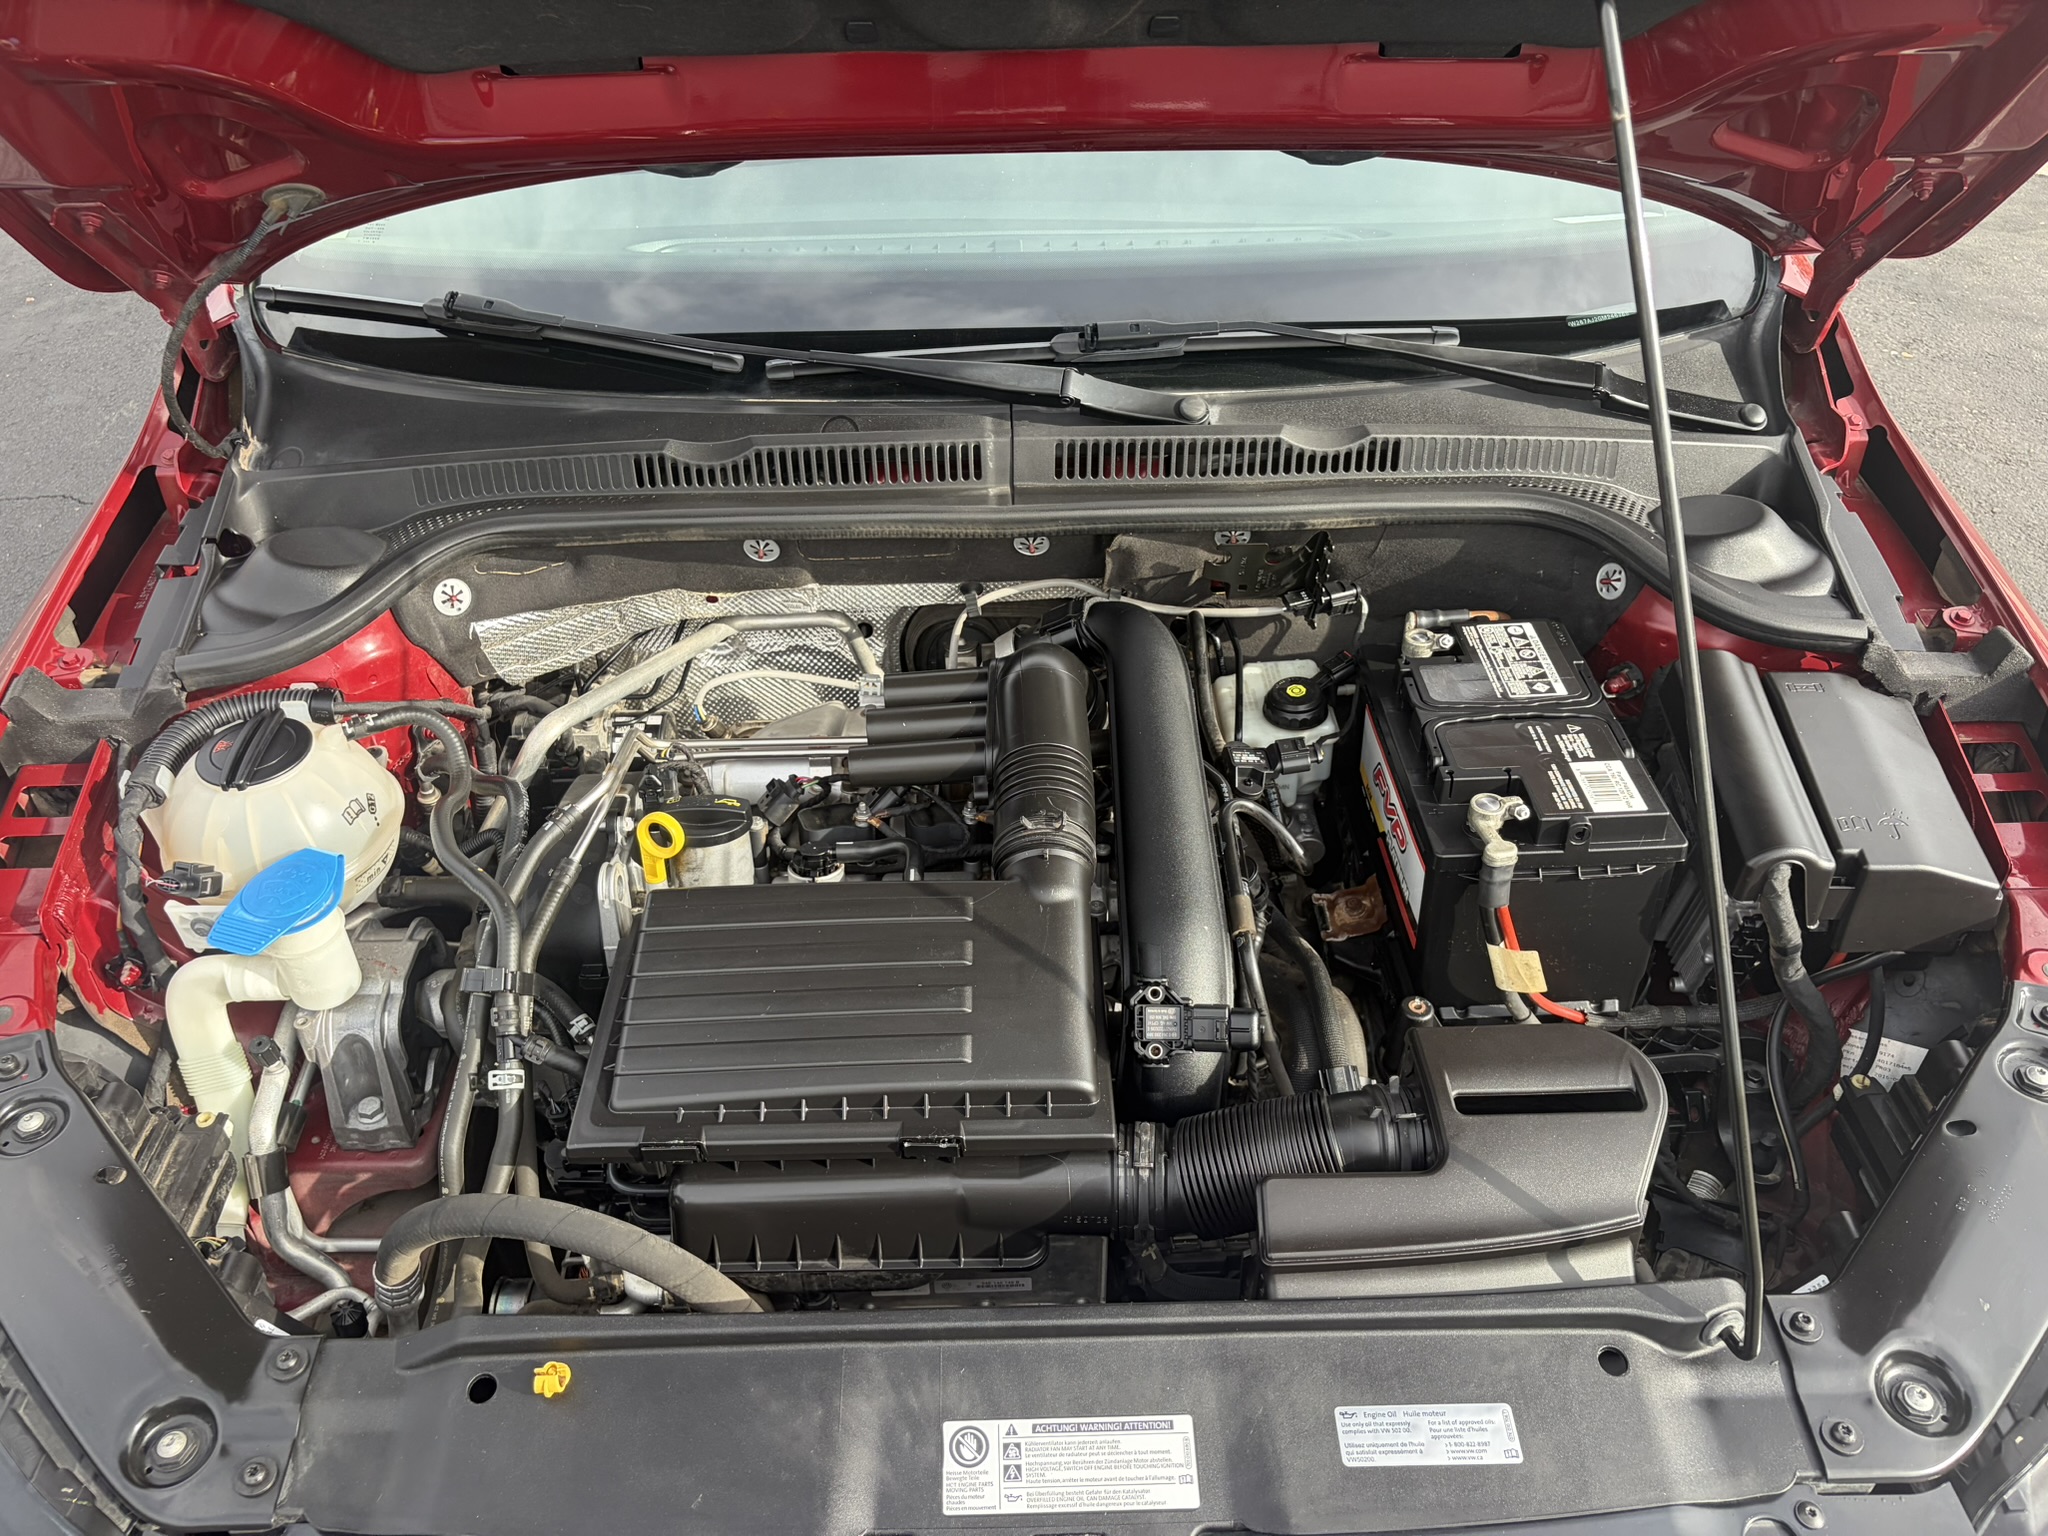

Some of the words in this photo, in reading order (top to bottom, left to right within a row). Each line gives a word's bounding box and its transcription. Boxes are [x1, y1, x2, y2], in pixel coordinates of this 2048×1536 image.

[1372, 762, 1407, 853] FVP
[366, 867, 381, 882] min
[1363, 1411, 1385, 1419] Engine
[1035, 1423, 1077, 1432] ACHTUNG!
[1080, 1422, 1122, 1431] WARNING!
[1124, 1421, 1170, 1430] ATTENTION!
